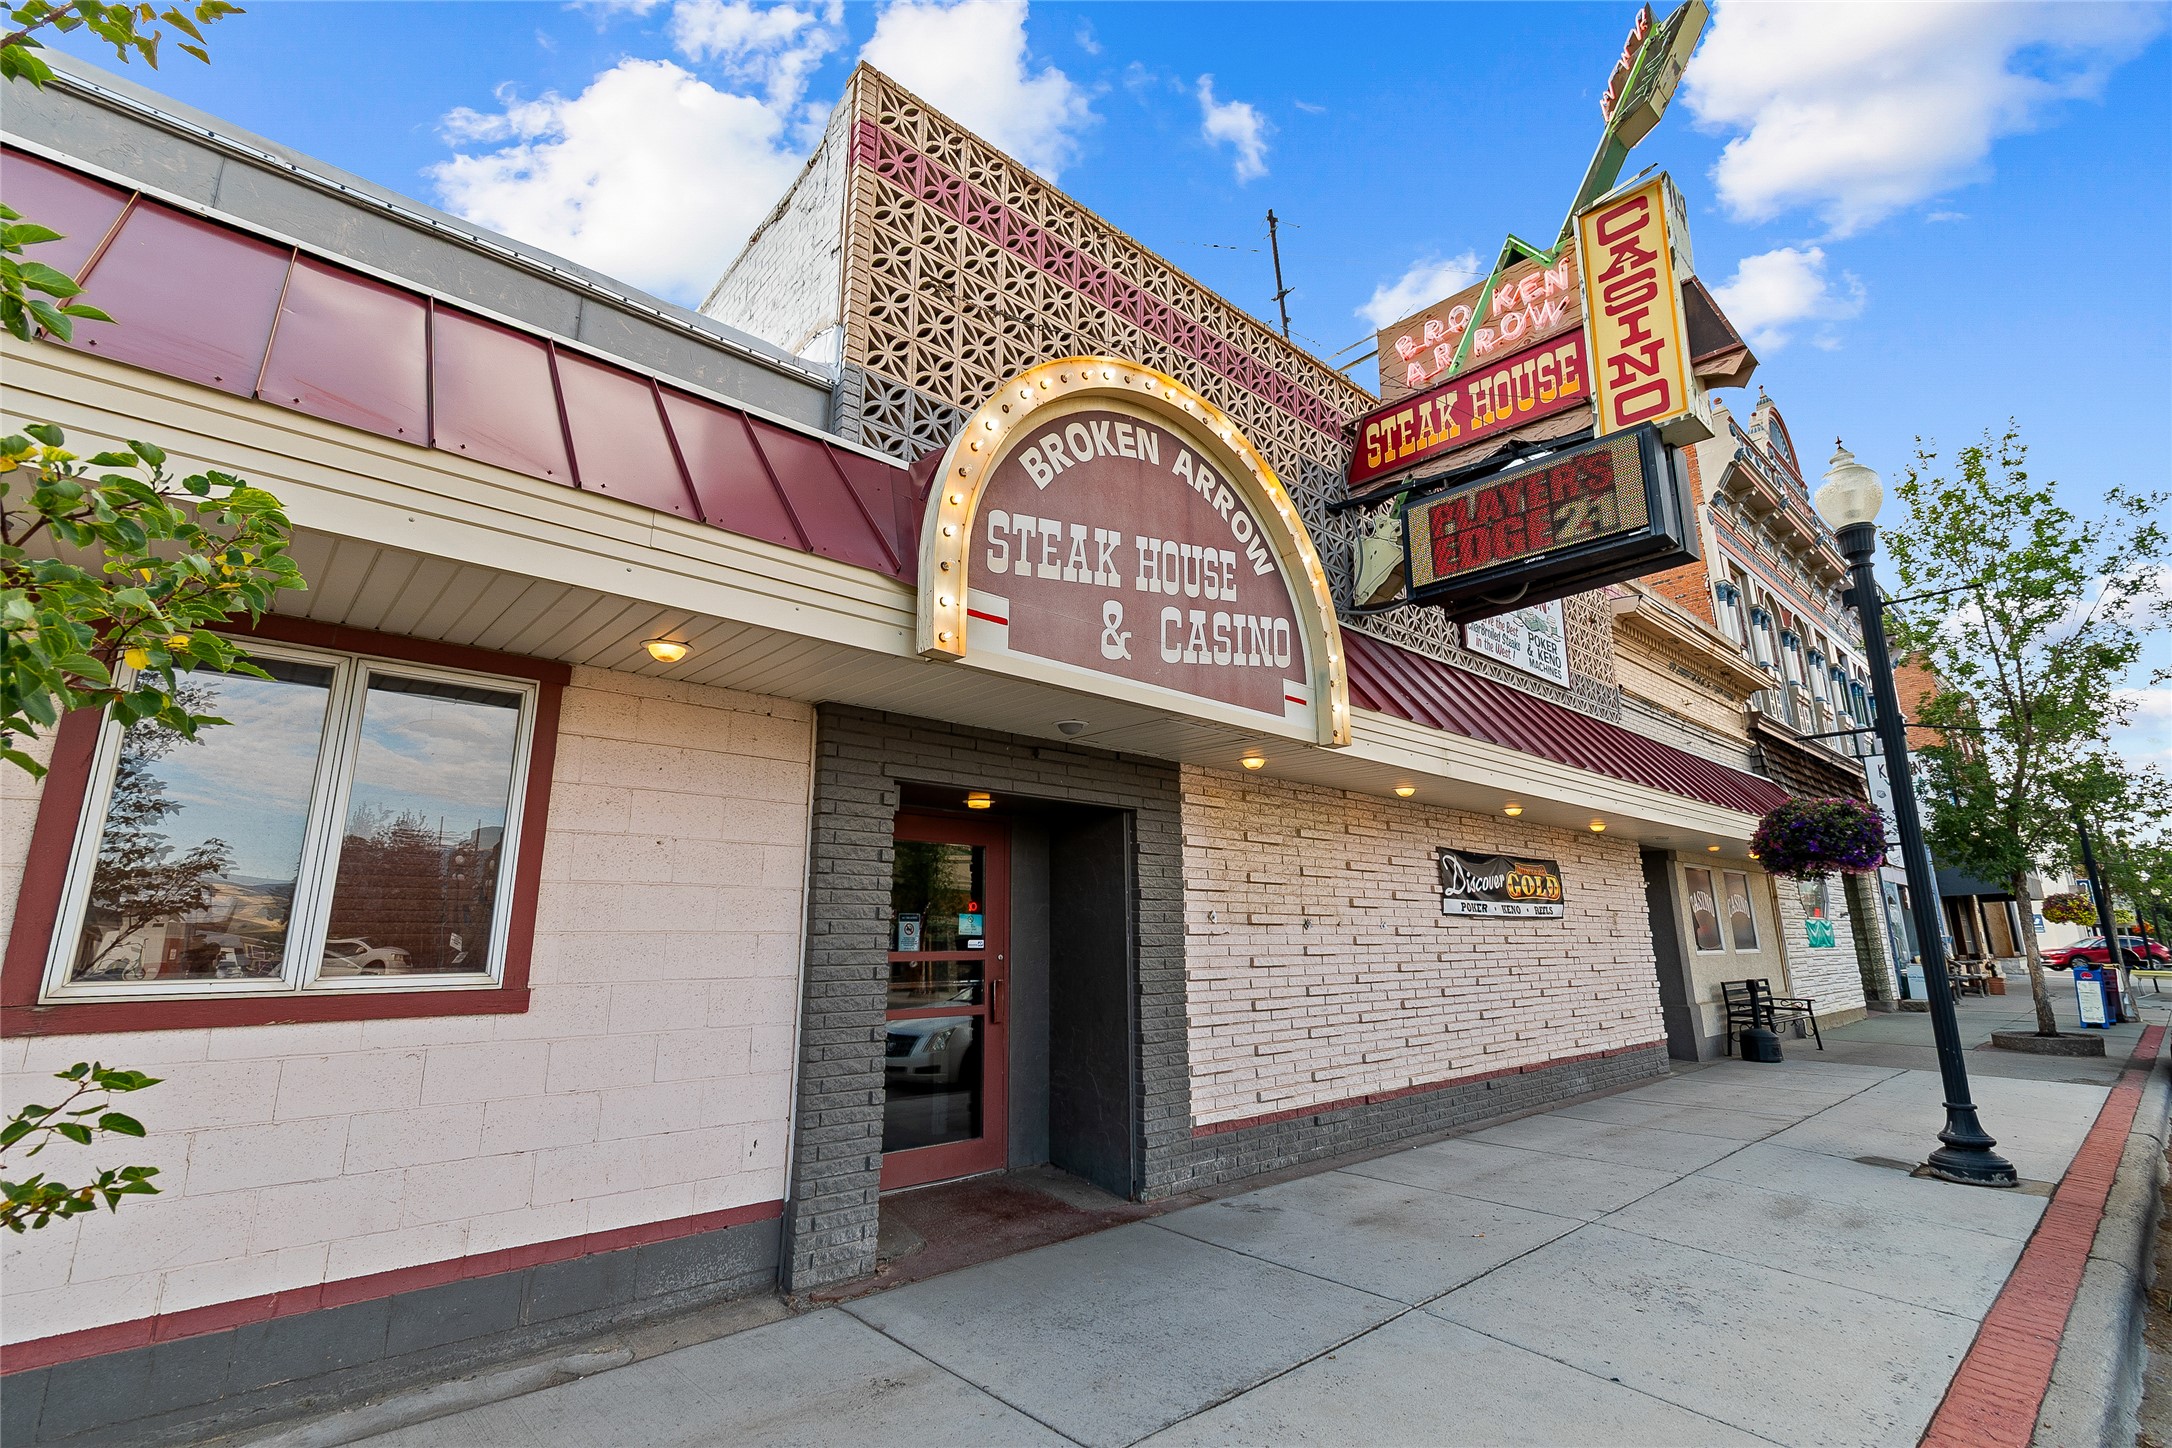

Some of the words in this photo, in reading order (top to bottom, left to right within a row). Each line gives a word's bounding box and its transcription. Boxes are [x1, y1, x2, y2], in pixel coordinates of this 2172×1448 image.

[1595, 195, 1671, 426] CASINO
[1366, 390, 1461, 469] STEAK
[1468, 341, 1581, 431] HOUSE
[1018, 420, 1159, 490] BROKEN
[1172, 449, 1275, 576] ARROW
[987, 509, 1121, 588] STEAK
[1135, 535, 1237, 602] HOUSE
[1432, 508, 1553, 577] EDGE
[1101, 600, 1132, 661] &
[1160, 606, 1291, 669] CASINO
[1496, 616, 1505, 631] the
[1506, 621, 1519, 638] Best
[1475, 634, 1482, 648] in
[1484, 638, 1494, 653] the
[1502, 633, 1521, 651] Steaks
[1527, 631, 1558, 655] POKER
[1526, 644, 1534, 657] &
[1537, 648, 1562, 669] KENO
[1528, 657, 1562, 680] MACHINES
[1442, 854, 1505, 896] Discover
[1507, 873, 1560, 899] GOLD
[1461, 902, 1488, 913] POKER
[1501, 904, 1521, 914] KENO
[1534, 905, 1554, 915] REELS
[1689, 890, 1715, 918] CASINO
[1727, 894, 1750, 919] CASINO
